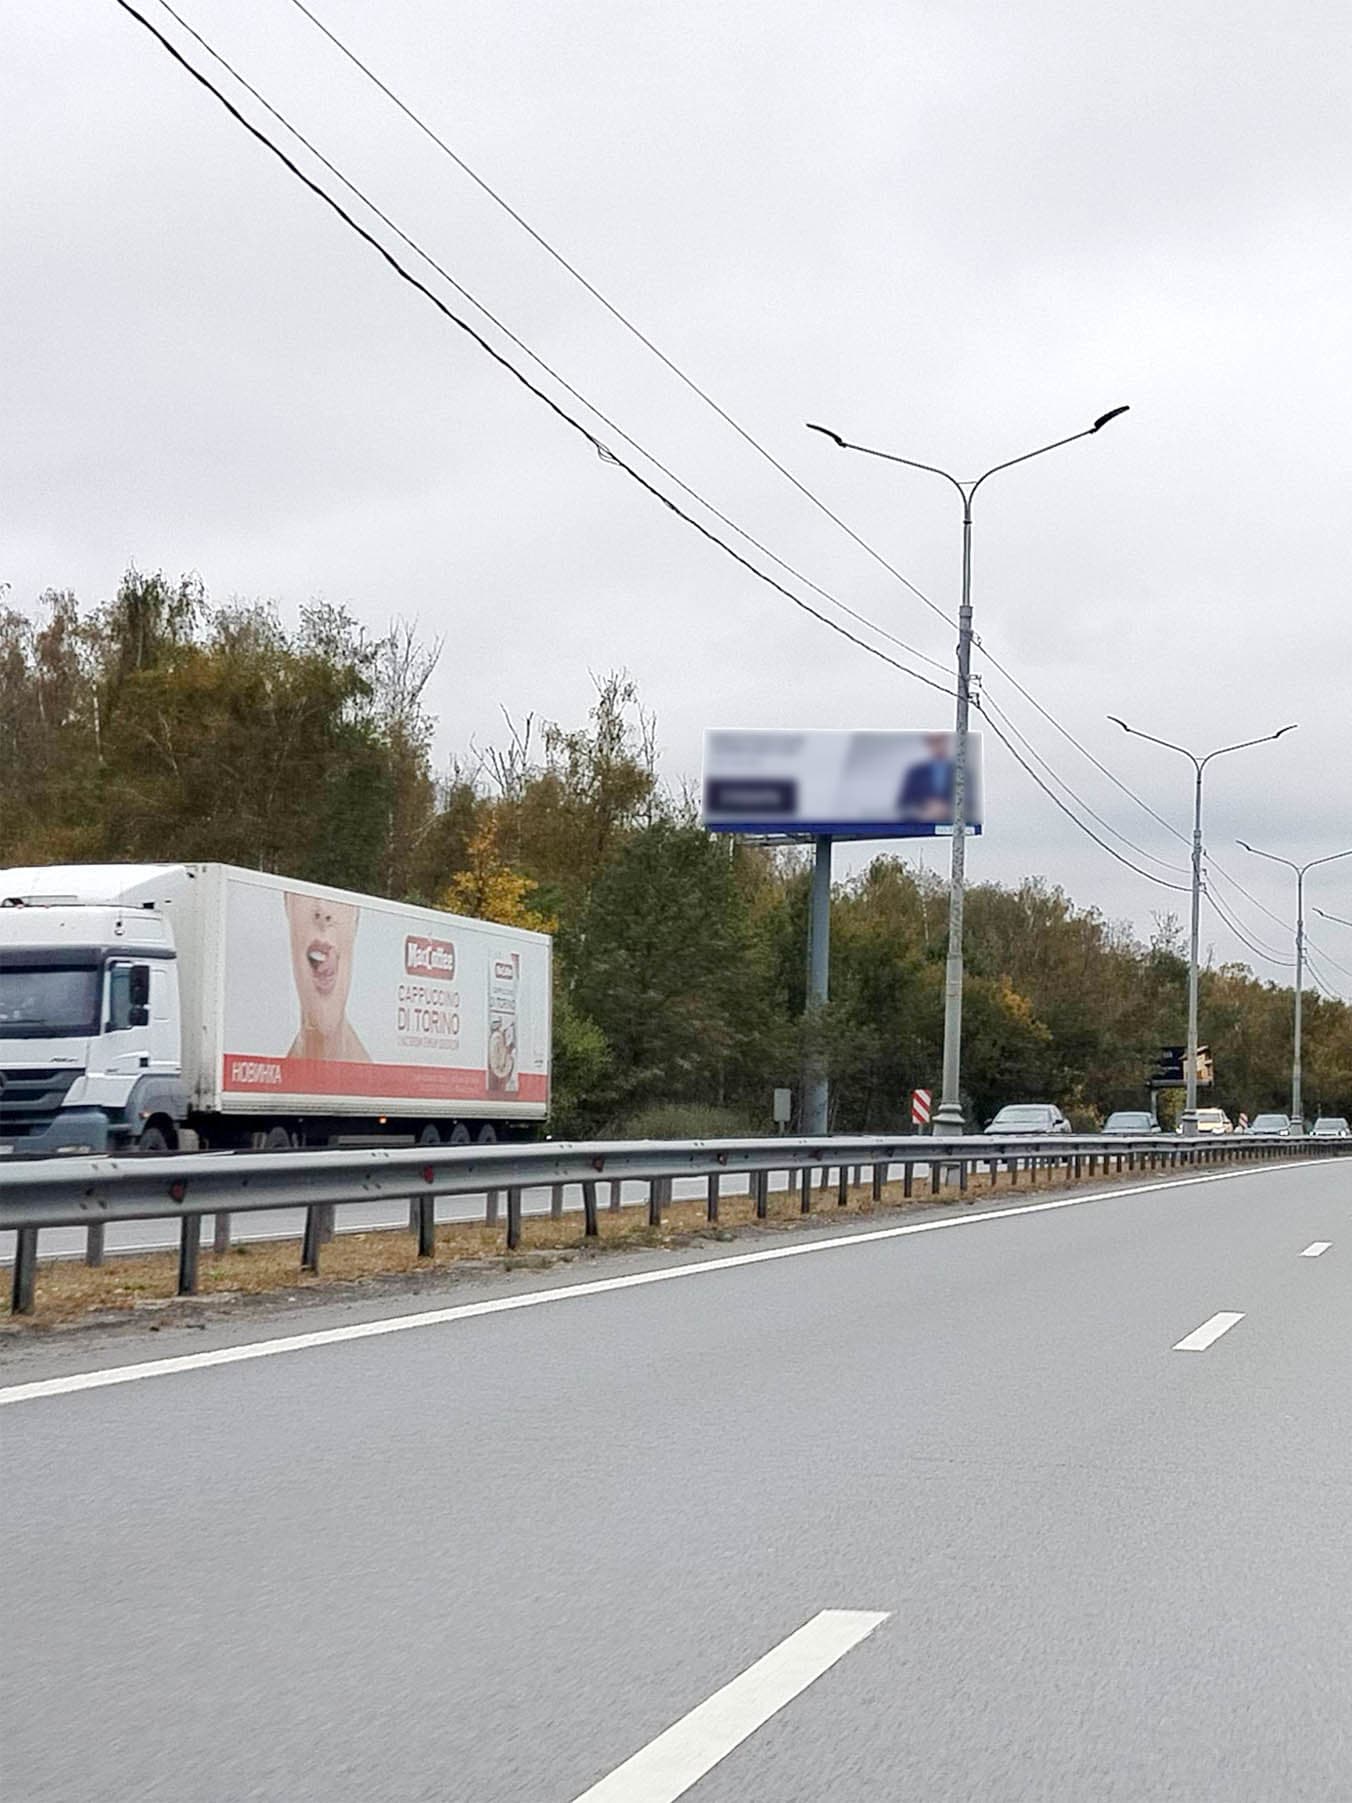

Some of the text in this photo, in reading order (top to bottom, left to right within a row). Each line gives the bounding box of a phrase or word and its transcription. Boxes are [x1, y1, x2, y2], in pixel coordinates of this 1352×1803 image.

[398, 985, 460, 1008] CAPPUCCINO
[398, 1007, 460, 1035] DI TORINO
[232, 1062, 282, 1084] НОВИНКА
